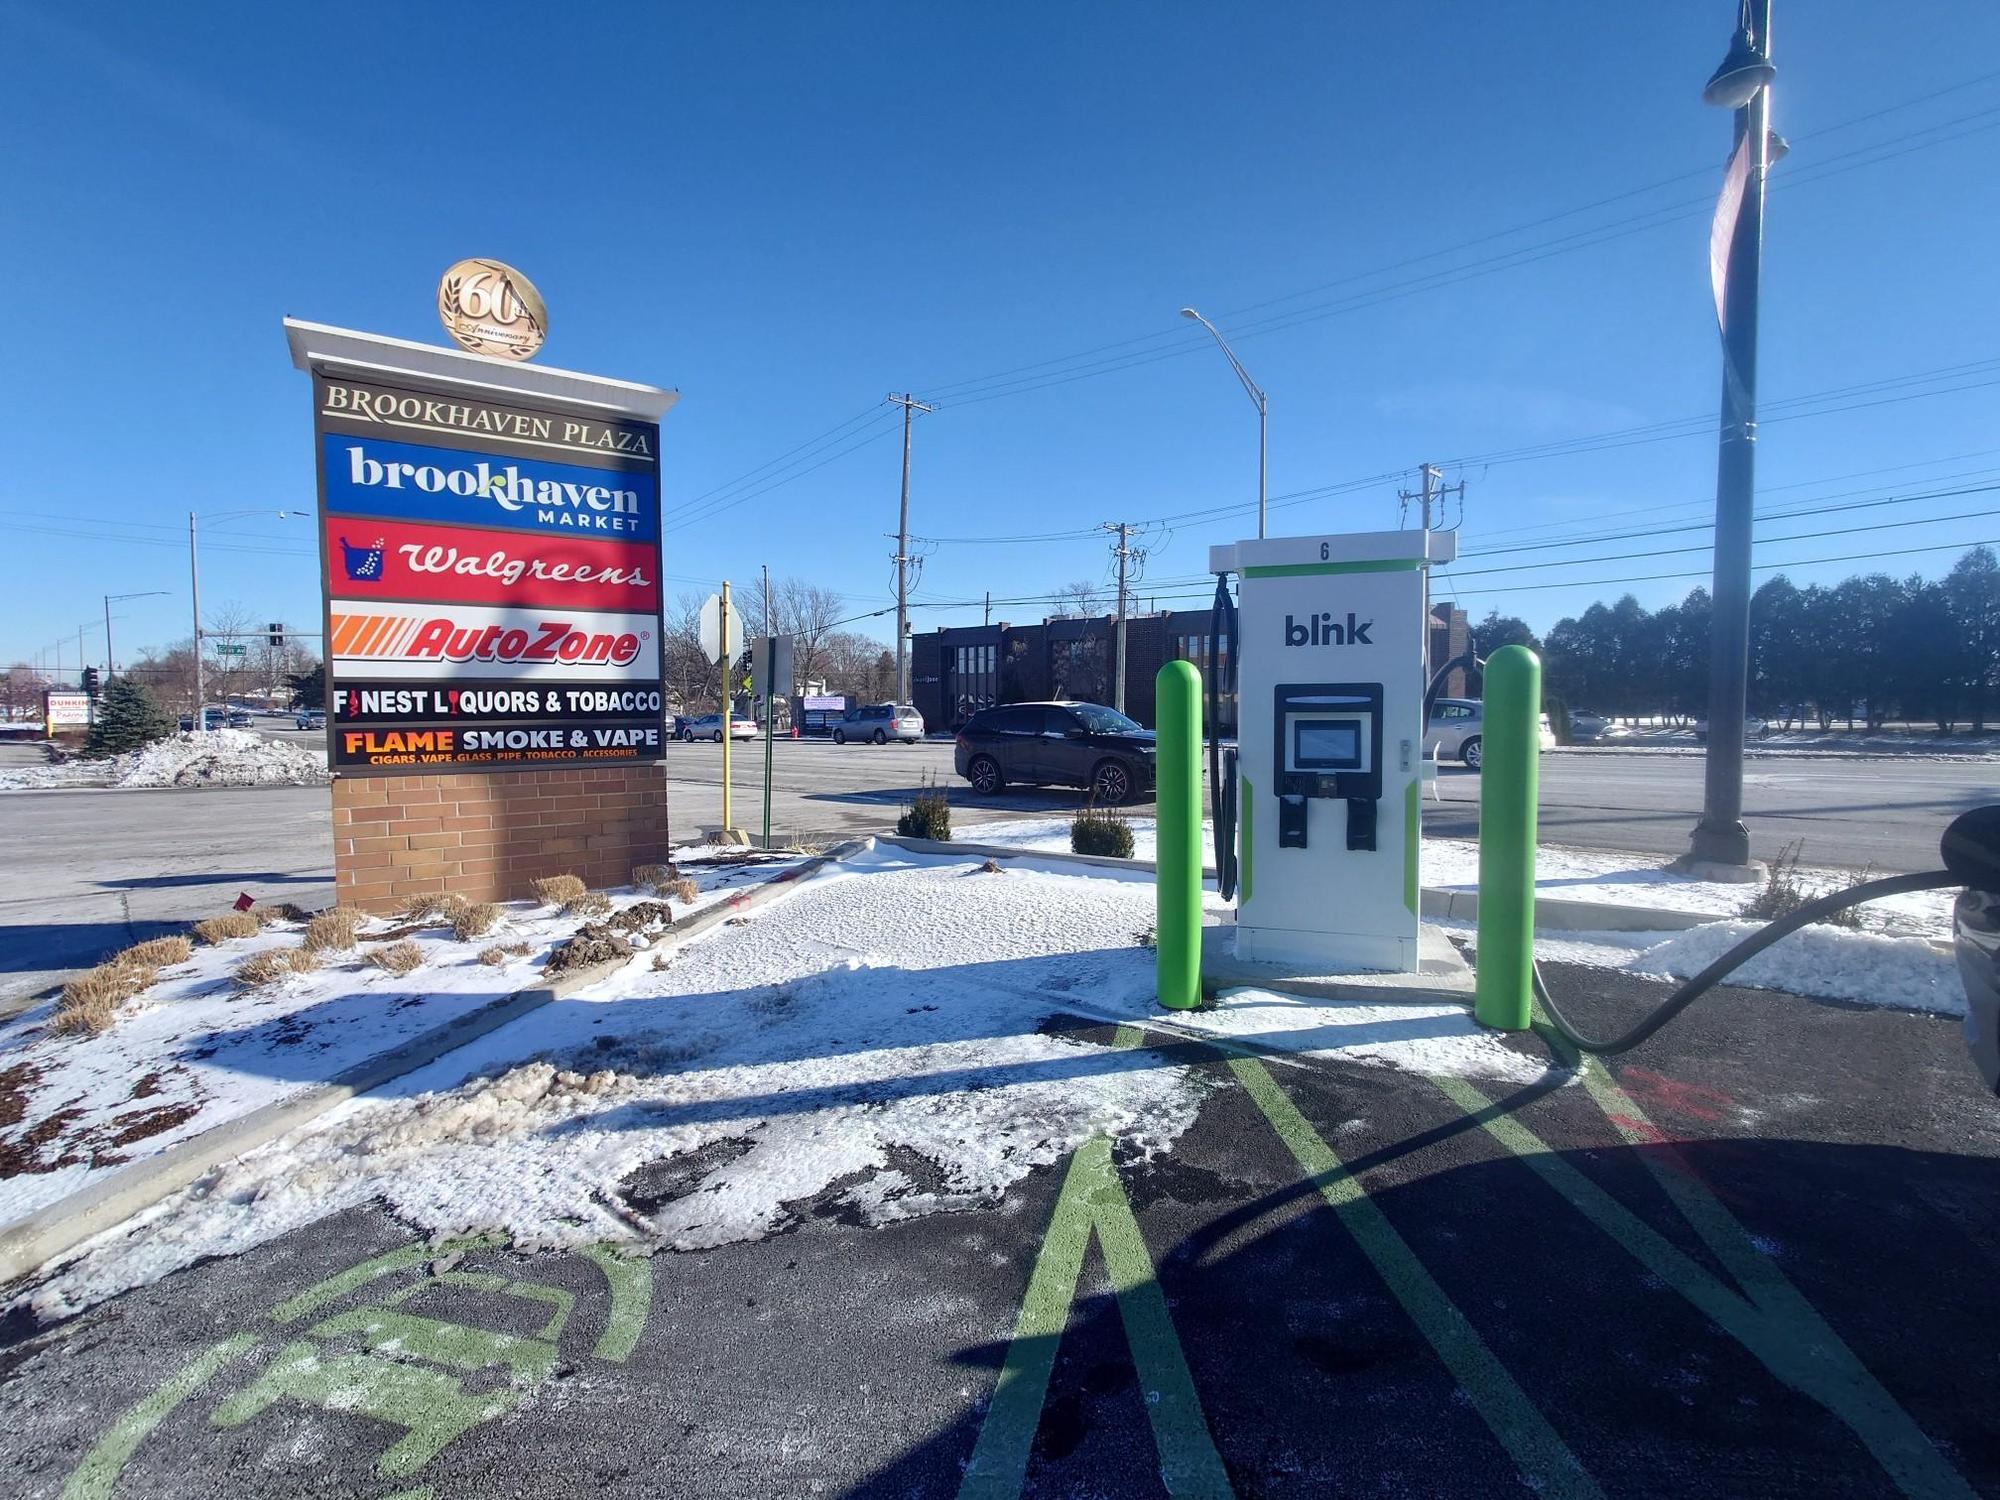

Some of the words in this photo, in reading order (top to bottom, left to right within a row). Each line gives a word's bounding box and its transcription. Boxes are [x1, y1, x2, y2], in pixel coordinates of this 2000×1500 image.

[325, 385, 552, 439] BROOKHAVEN
[563, 421, 650, 454] PLAZA
[345, 446, 641, 514] brookhaven
[538, 509, 639, 531] MARKET
[399, 543, 651, 587] Walgreens
[1320, 542, 1329, 560] 6
[405, 618, 641, 667] AutoZone
[1285, 612, 1374, 646] blink
[546, 691, 561, 712] &
[566, 690, 660, 712] TOBACCO
[344, 731, 454, 753] FLAME
[463, 730, 563, 750] SMOKE
[570, 730, 588, 747] &
[593, 728, 658, 747] VAPE
[525, 750, 576, 760] TOBACCO
[582, 748, 638, 759] ACCESSORIES
